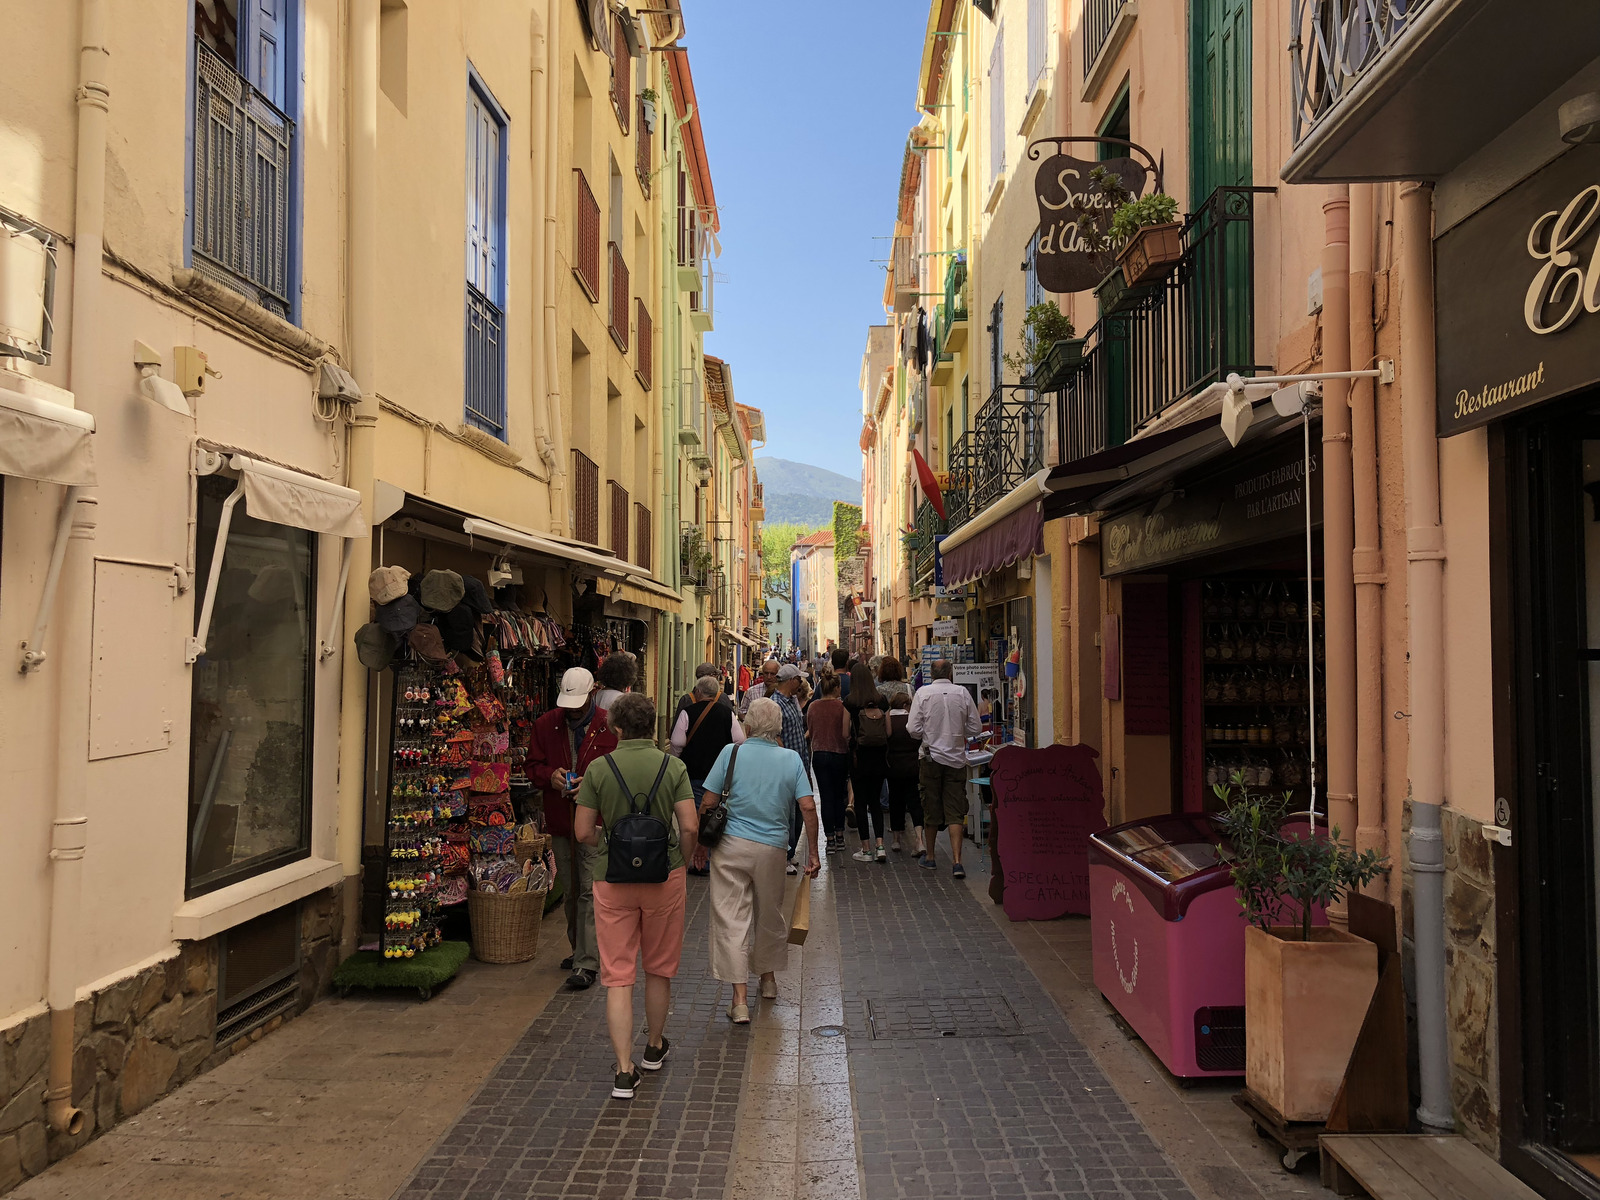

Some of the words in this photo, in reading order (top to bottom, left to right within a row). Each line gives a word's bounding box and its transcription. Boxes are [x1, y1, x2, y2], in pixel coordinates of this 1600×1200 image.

[1454, 361, 1545, 419] Restaurant
[1234, 472, 1271, 499] PRODUITS
[1246, 501, 1261, 519] PAR
[1261, 488, 1301, 515] L'ARTISAN
[1024, 887, 1090, 902] CATALAN
